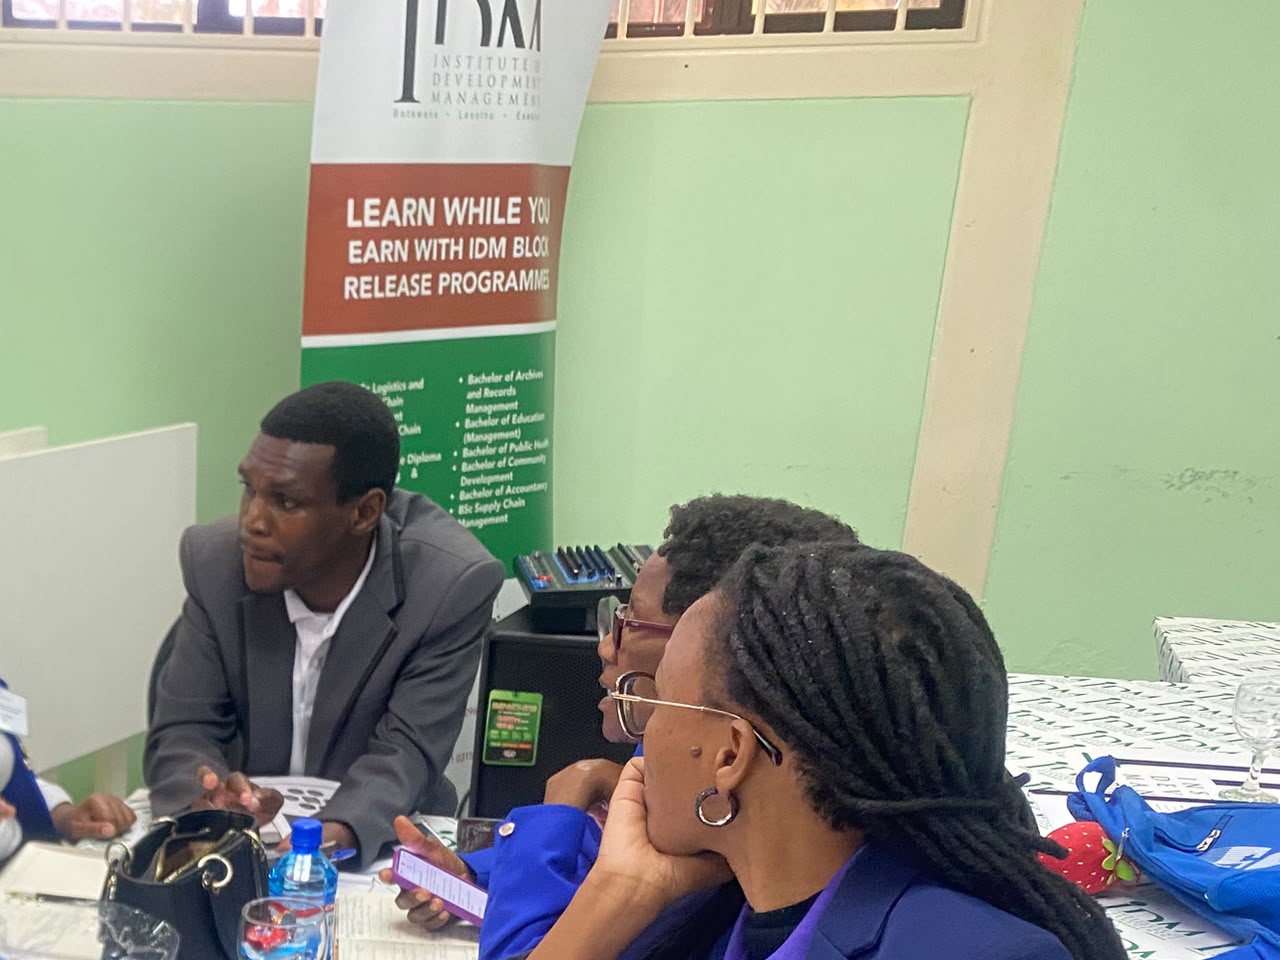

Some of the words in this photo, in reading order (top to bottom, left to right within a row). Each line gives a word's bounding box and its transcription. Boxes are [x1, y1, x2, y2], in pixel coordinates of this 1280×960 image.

[433, 54, 528, 71] INSTITUTE
[346, 198, 435, 228] LEARN
[442, 196, 521, 226] WHILE
[528, 196, 550, 224] YOU
[348, 239, 409, 264] EARN
[414, 238, 464, 262] WITH
[469, 236, 507, 260] IDM
[344, 273, 432, 300] RELEASE
[372, 380, 407, 395] Logistics
[408, 378, 424, 390] and
[468, 374, 502, 385] Bachelor
[504, 373, 514, 383] of
[467, 388, 481, 399] and
[483, 386, 516, 398] Records
[466, 401, 518, 415] Management
[398, 423, 421, 436] Chain
[465, 417, 498, 429] Bachelor
[501, 415, 510, 426] of
[462, 446, 496, 458] Bachelor
[498, 444, 508, 455] of
[509, 441, 532, 453] Public
[461, 460, 495, 472] Bachelor
[497, 458, 507, 468] of
[460, 472, 513, 487] Development
[459, 489, 493, 501] Bachelor
[495, 486, 505, 497] of
[474, 502, 501, 514] Supply
[503, 498, 525, 509] Chain
